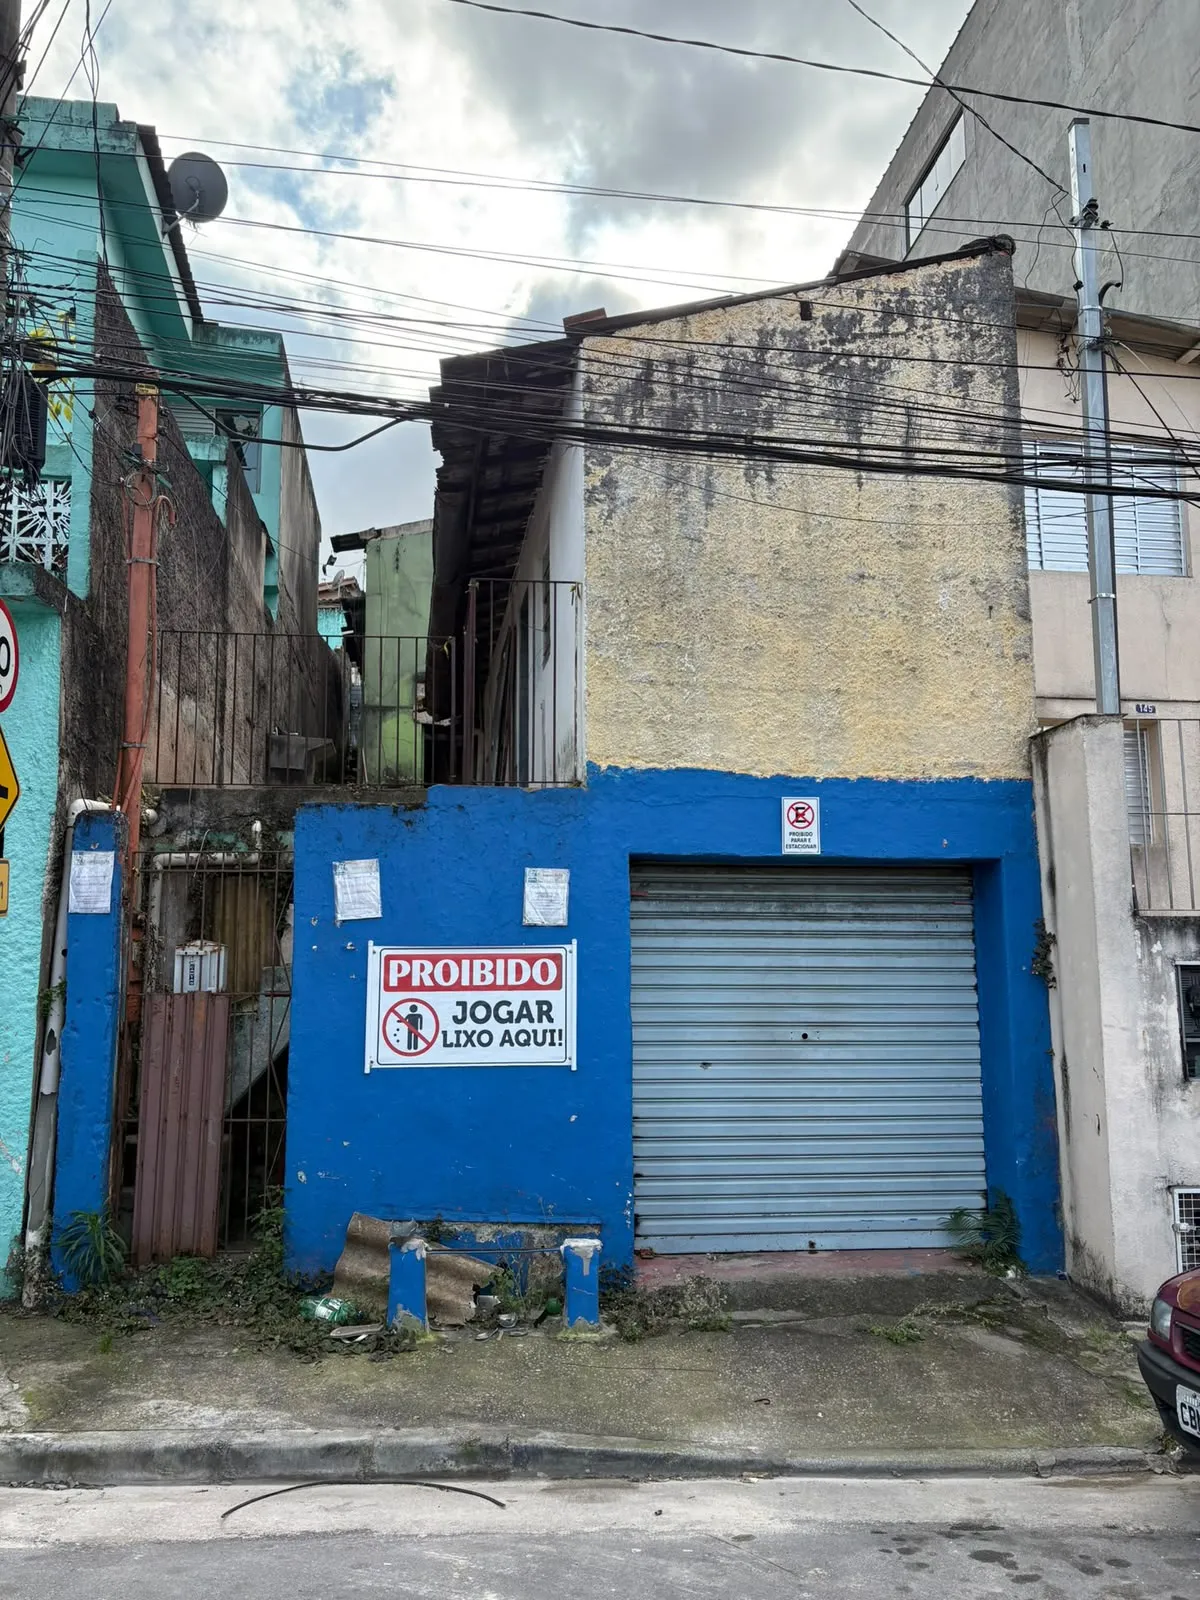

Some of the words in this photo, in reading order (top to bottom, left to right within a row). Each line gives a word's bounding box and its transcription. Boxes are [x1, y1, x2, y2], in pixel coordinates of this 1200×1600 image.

[1139, 704, 1152, 712] 145
[389, 958, 558, 987] PROIBIDO
[452, 1000, 554, 1025] JOGAR
[441, 1030, 494, 1048] LIXO
[500, 1029, 563, 1048] AQUI!
